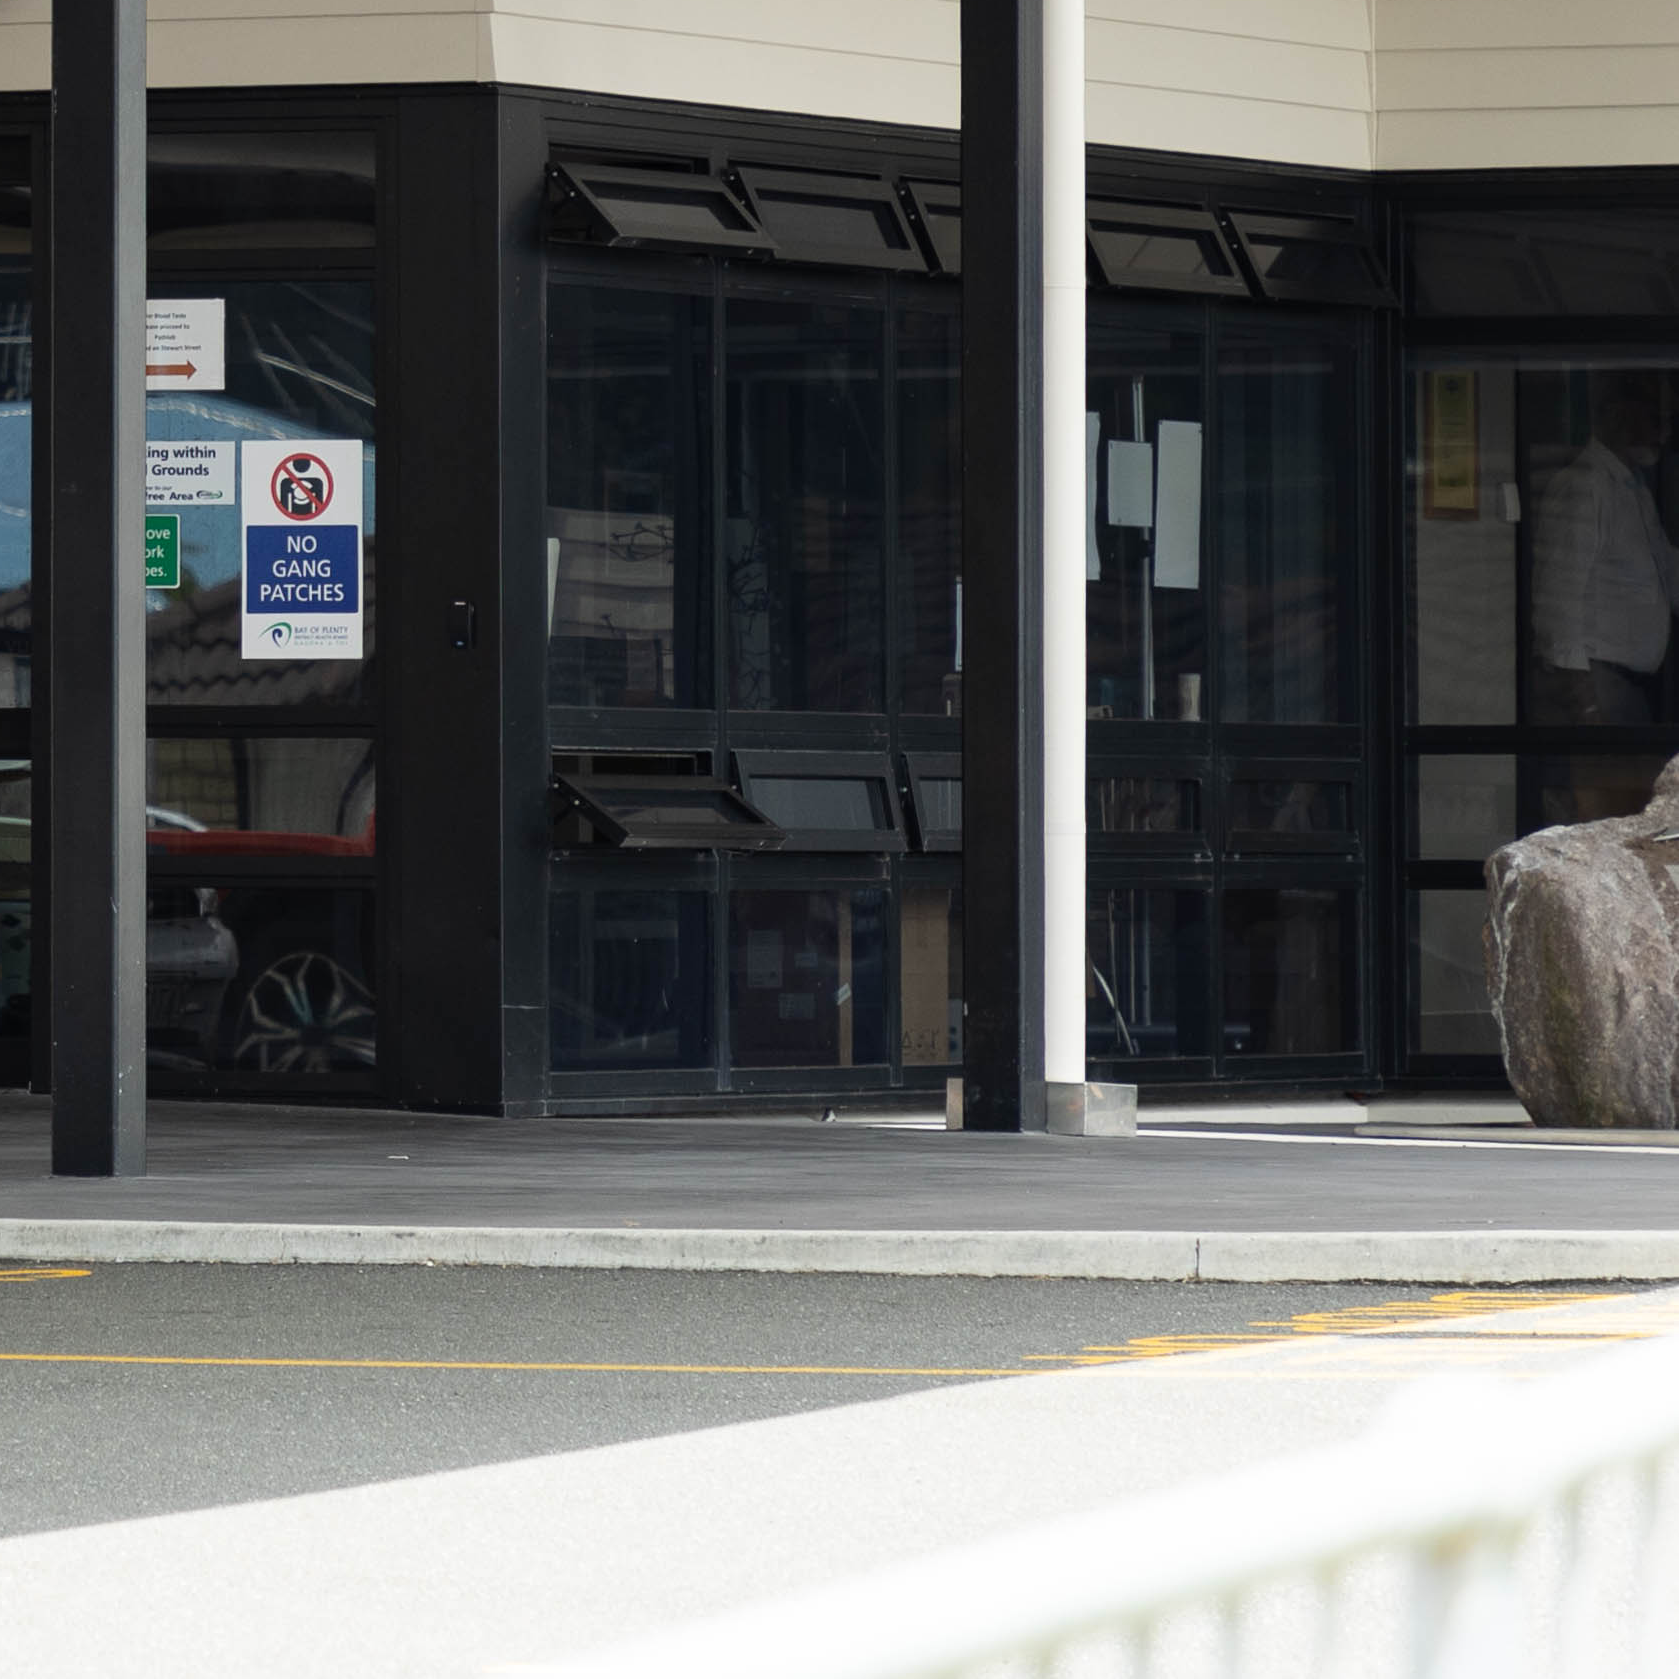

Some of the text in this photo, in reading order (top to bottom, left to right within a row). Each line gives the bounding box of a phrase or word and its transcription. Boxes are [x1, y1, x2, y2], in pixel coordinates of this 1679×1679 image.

[173, 446, 215, 458] within
[152, 464, 209, 476] Grounds
[170, 492, 193, 500] Area
[146, 528, 170, 540] ove
[288, 536, 316, 553] NO
[273, 560, 330, 577] GANG
[261, 584, 343, 601] PATCHES
